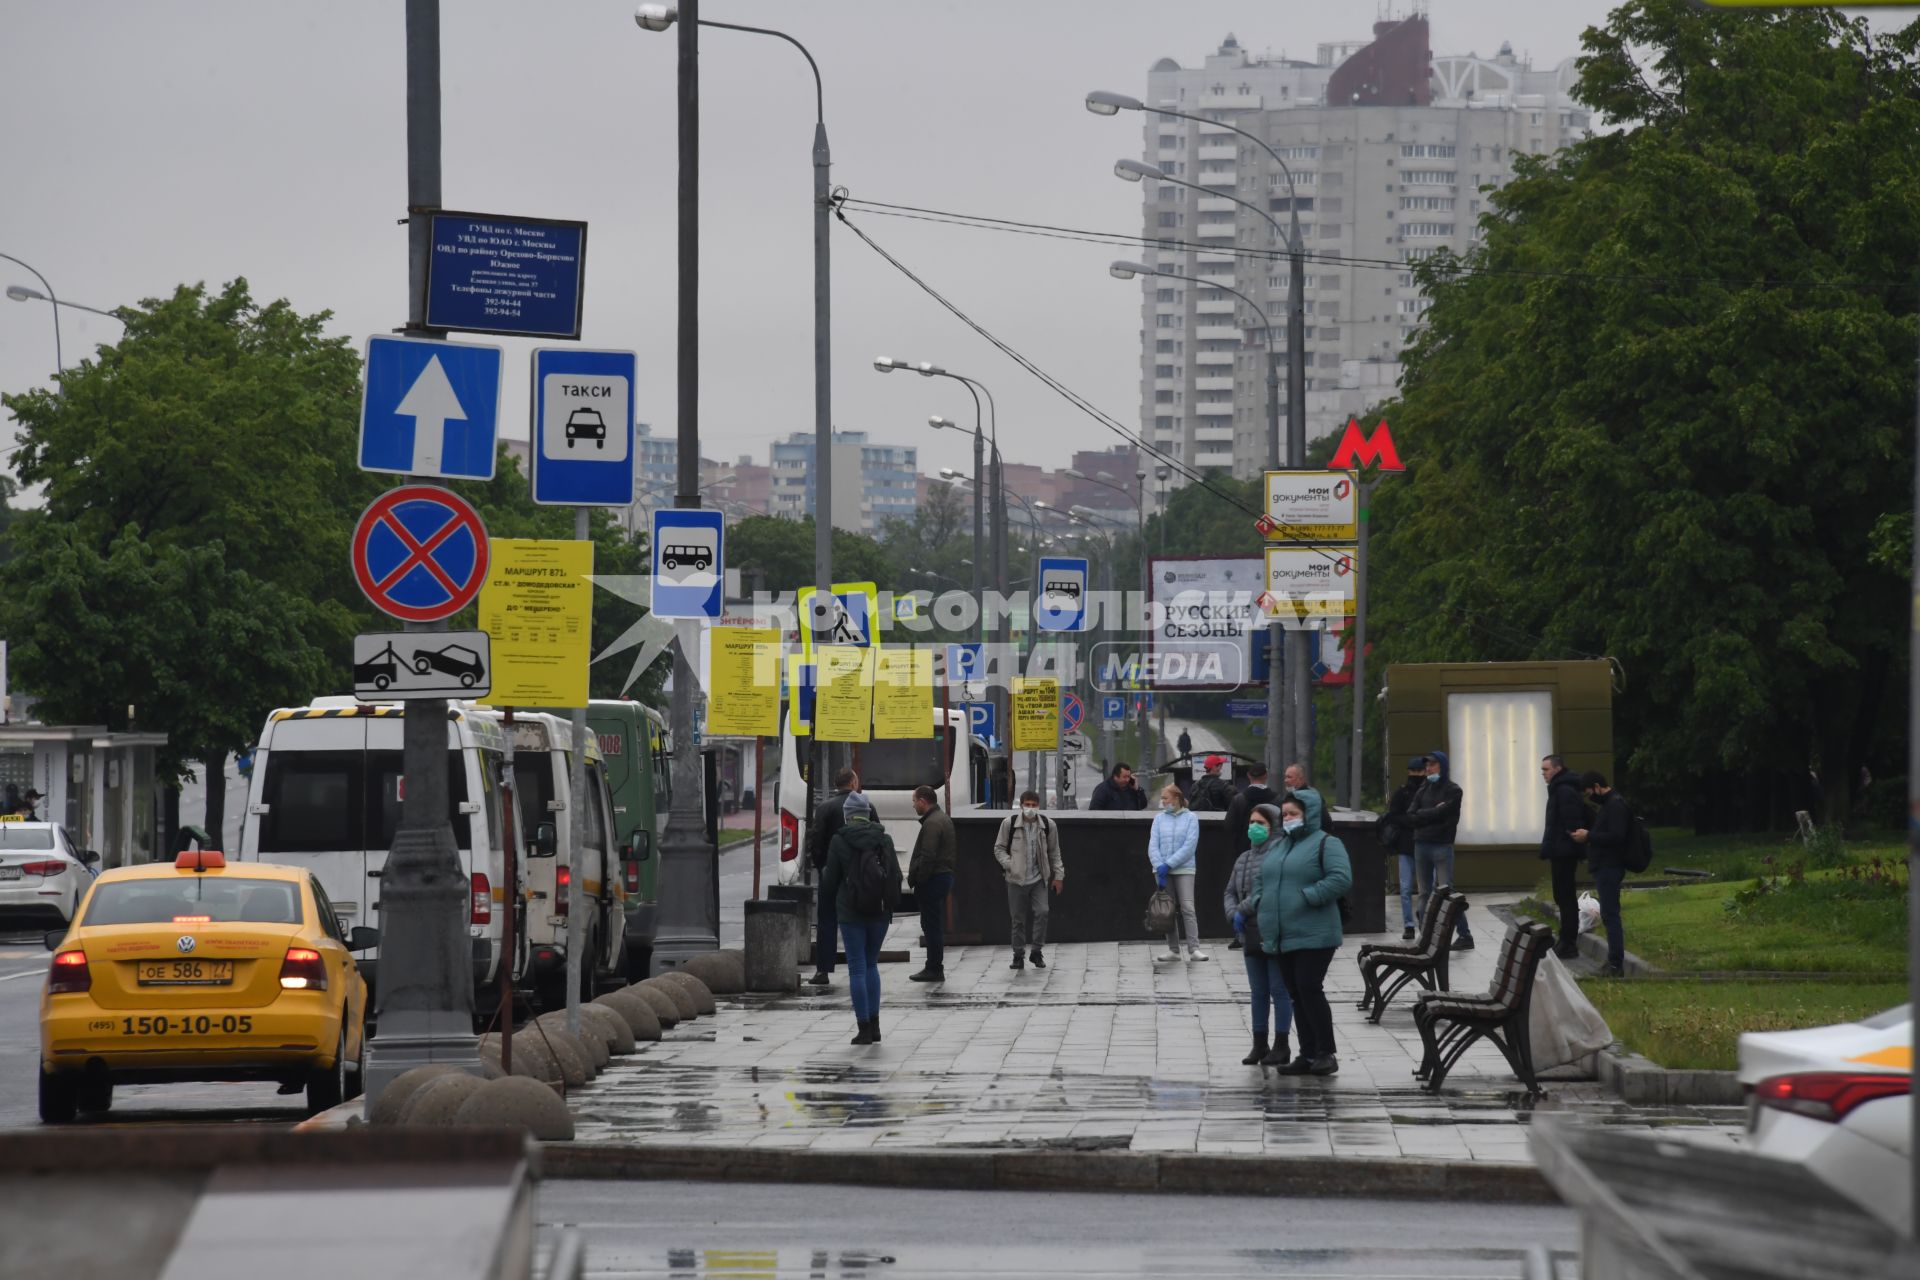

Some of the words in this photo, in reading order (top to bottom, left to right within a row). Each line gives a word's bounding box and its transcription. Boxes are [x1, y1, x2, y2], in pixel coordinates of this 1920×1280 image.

[469, 224, 493, 234] ГУВД
[494, 227, 505, 235] по
[515, 229, 546, 237] Москве
[457, 234, 476, 244] УВД
[490, 237, 513, 246] ЮАО
[522, 240, 556, 249] Москвы
[437, 244, 456, 253] ОВД
[490, 260, 521, 270] Южное
[451, 284, 492, 295] Телефоны
[494, 287, 532, 298] дежурной
[533, 291, 556, 299] части
[485, 298, 521, 308] 392-94-44
[561, 384, 612, 398] такси
[1272, 494, 1330, 503] документы
[505, 567, 548, 577] МАРШРУТ
[1272, 570, 1330, 579] документы
[1165, 605, 1251, 620] РУССКИЕ
[1164, 622, 1244, 637] СЕЗОНЫ
[172, 962, 203, 979] 586
[88, 1020, 116, 1032] (495)
[122, 1014, 253, 1036] 150-10-05
